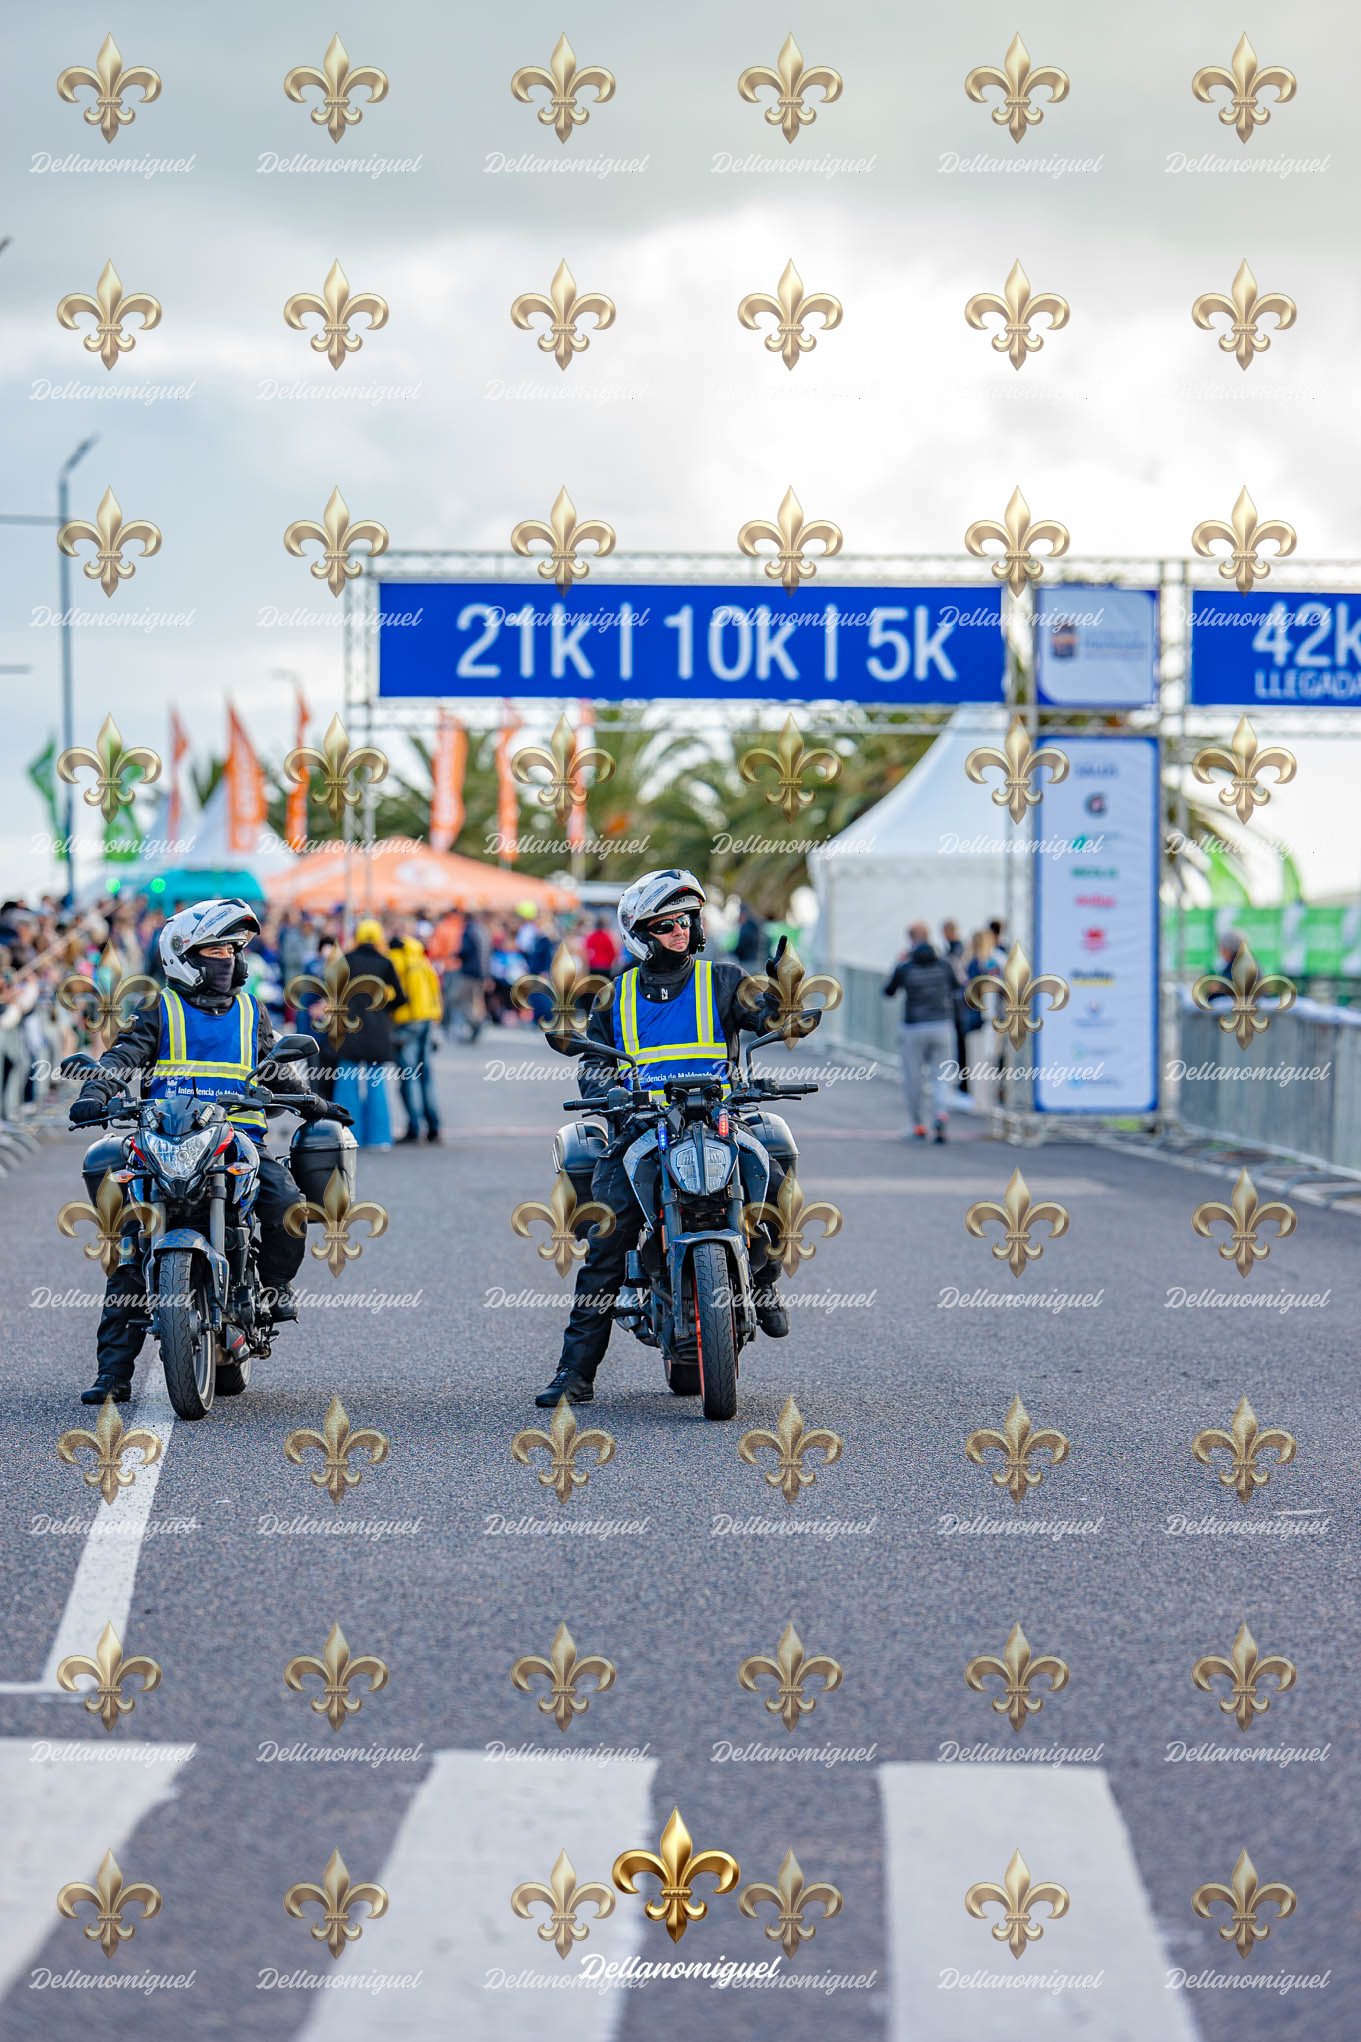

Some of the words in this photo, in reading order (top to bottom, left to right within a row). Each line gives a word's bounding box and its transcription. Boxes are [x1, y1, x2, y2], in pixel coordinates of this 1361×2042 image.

[457, 602, 595, 679] 21k
[664, 603, 800, 682] 10k
[866, 605, 958, 682] 5k
[1252, 601, 1361, 666] 42k
